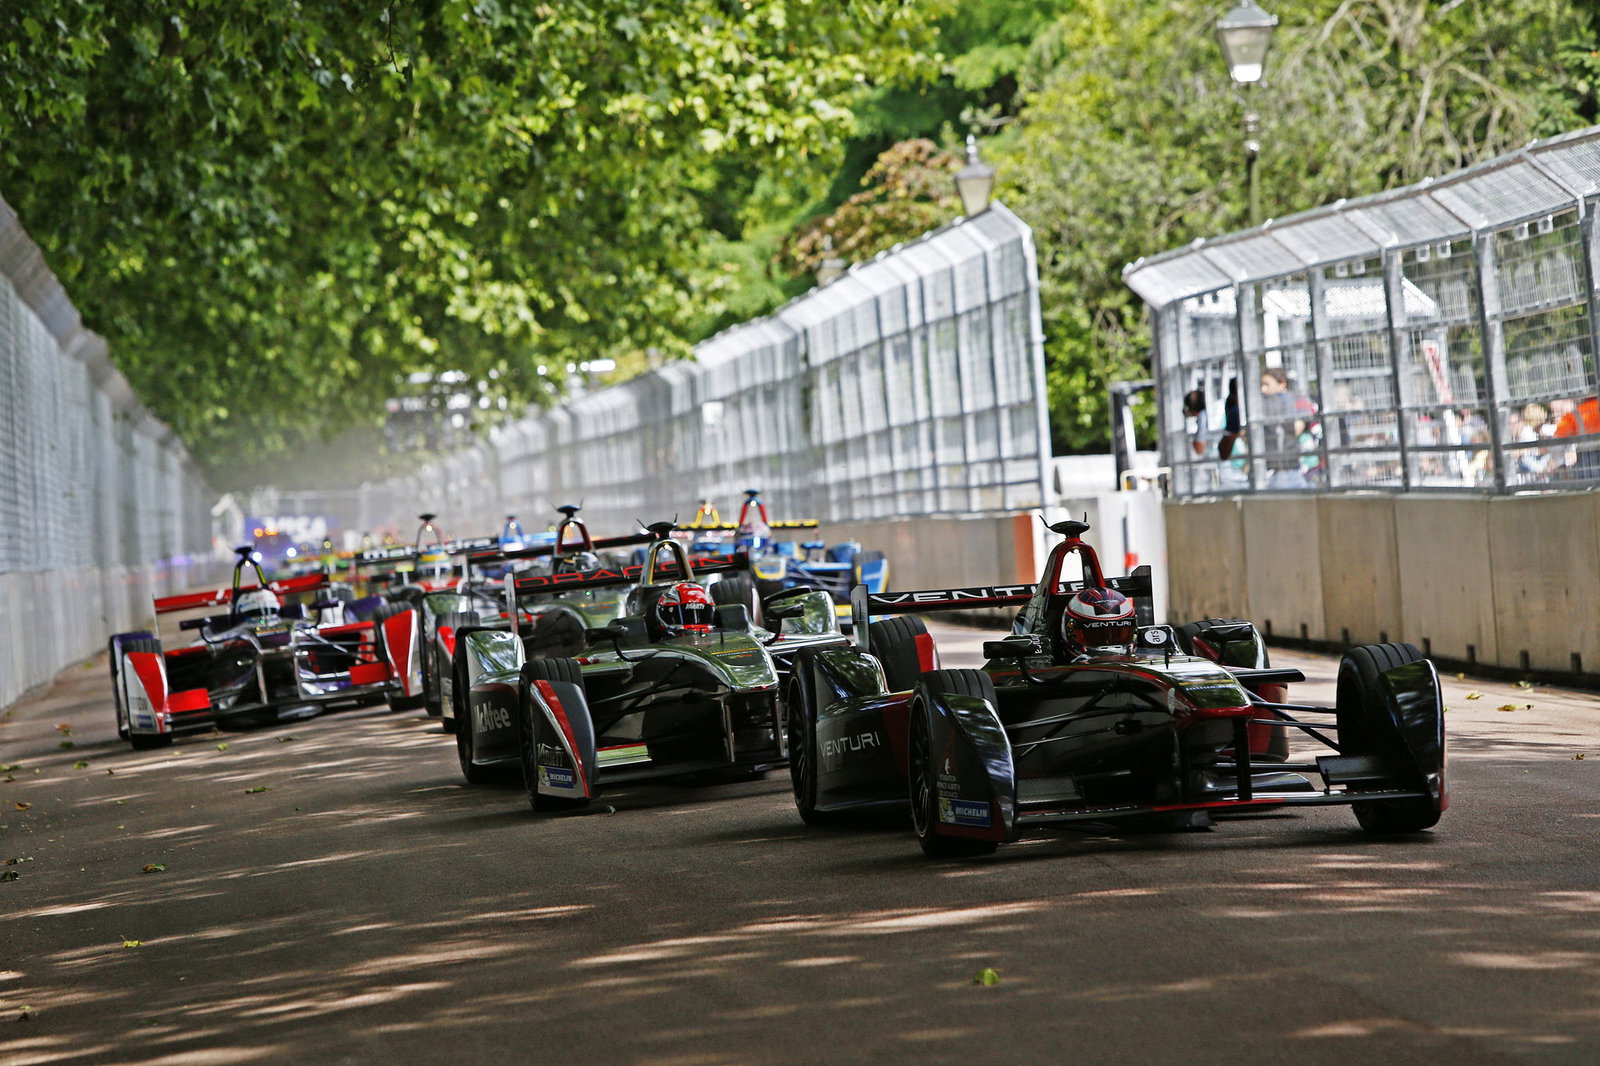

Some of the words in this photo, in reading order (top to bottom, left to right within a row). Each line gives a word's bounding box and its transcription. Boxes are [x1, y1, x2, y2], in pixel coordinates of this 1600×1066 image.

[515, 553, 735, 588] DRAGON
[820, 731, 881, 758] VENTURI
[955, 806, 989, 818] MICHELIN
